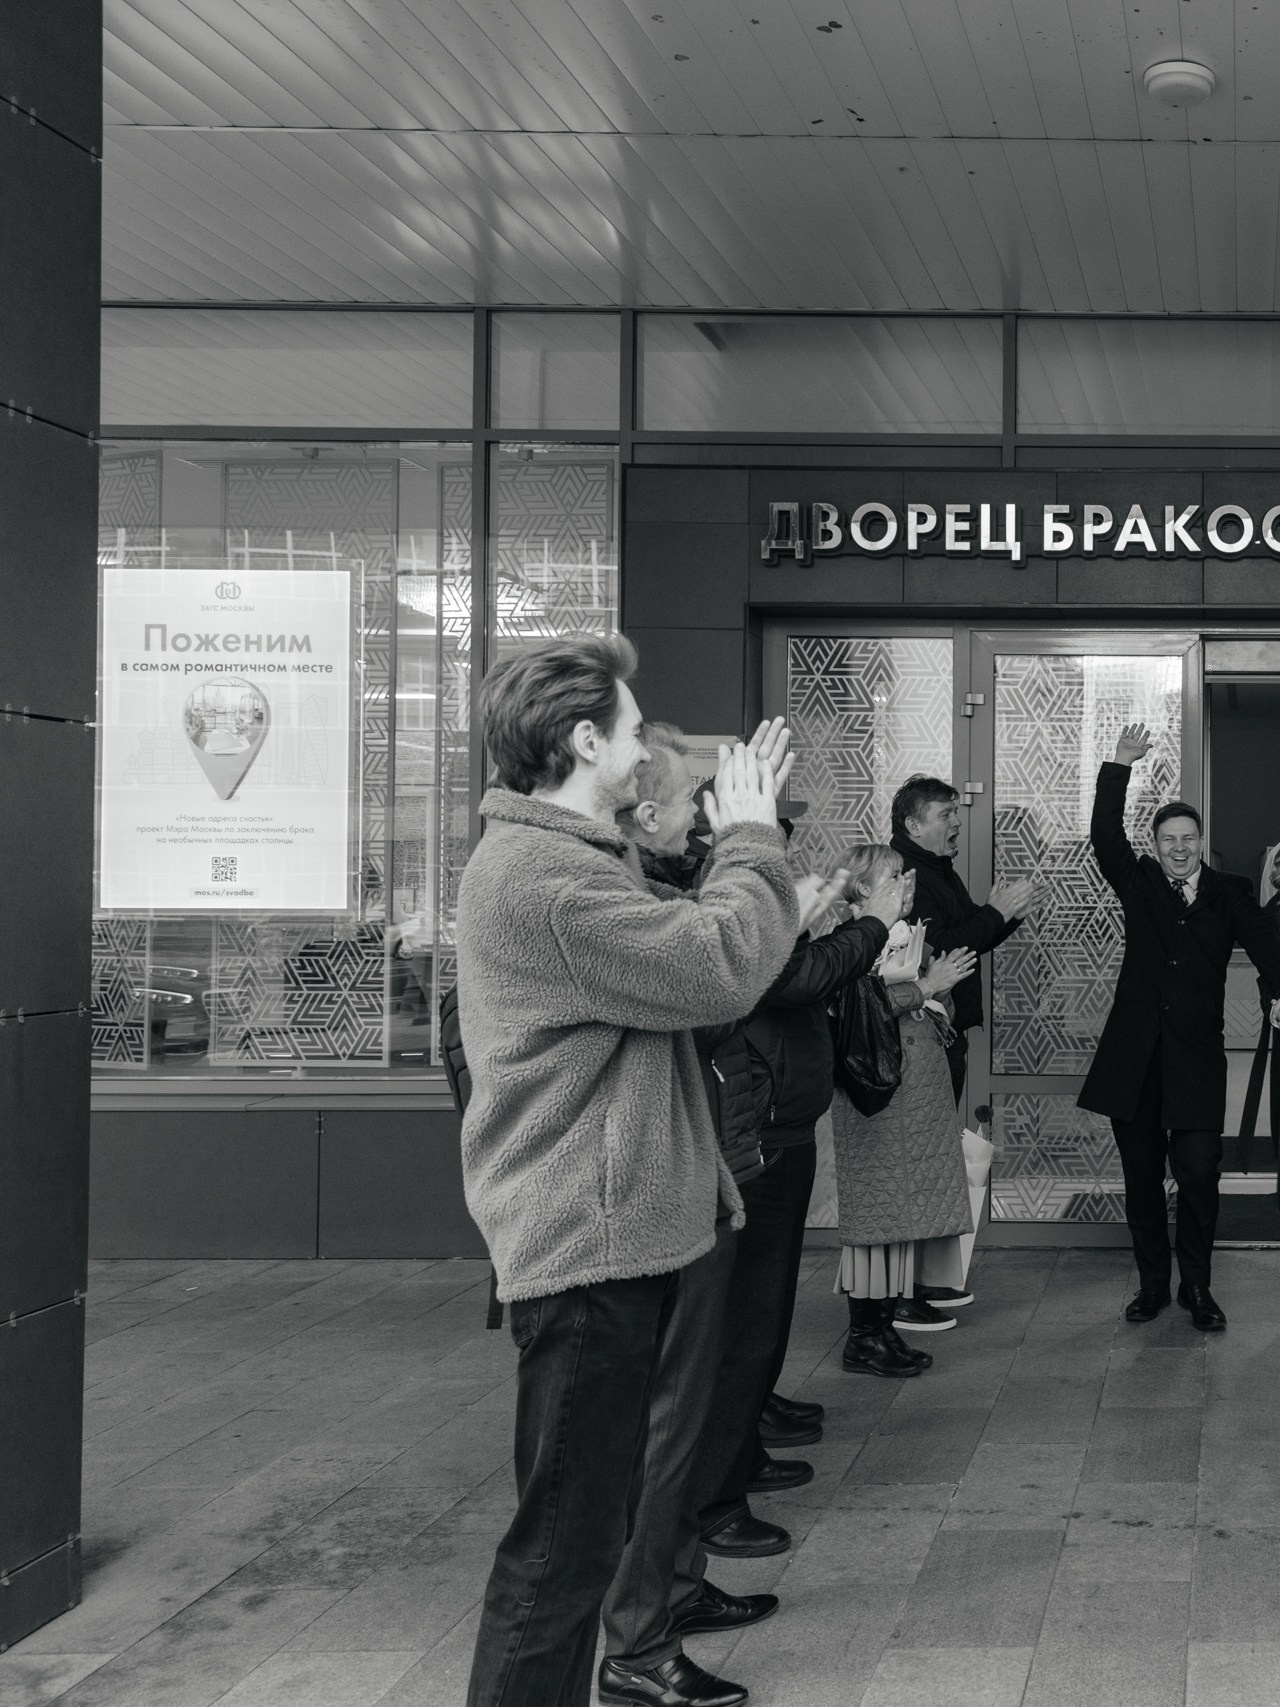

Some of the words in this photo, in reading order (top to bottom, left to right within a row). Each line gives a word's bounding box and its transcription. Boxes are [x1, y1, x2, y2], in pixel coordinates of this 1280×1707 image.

[760, 502, 1021, 561] ДВОРЕЦ
[200, 604, 219, 612] ЗАГС
[220, 604, 255, 612] МОСКВЫ
[144, 623, 313, 654] Поженим
[120, 663, 129, 672] в
[132, 662, 181, 673] самом
[184, 662, 288, 676] романтичном
[291, 663, 334, 674] месте
[175, 814, 207, 824] «Новые
[208, 815, 238, 824] адреса
[136, 826, 164, 834] проект
[165, 825, 189, 835] Мэра
[190, 825, 223, 834] Москвы
[224, 826, 235, 834] по
[236, 826, 288, 834] заключению
[288, 825, 315, 835] брака
[168, 835, 213, 845] необычных
[214, 837, 260, 846] площадках
[261, 837, 294, 846] столицы
[194, 888, 254, 898] mos.ru/svadba
